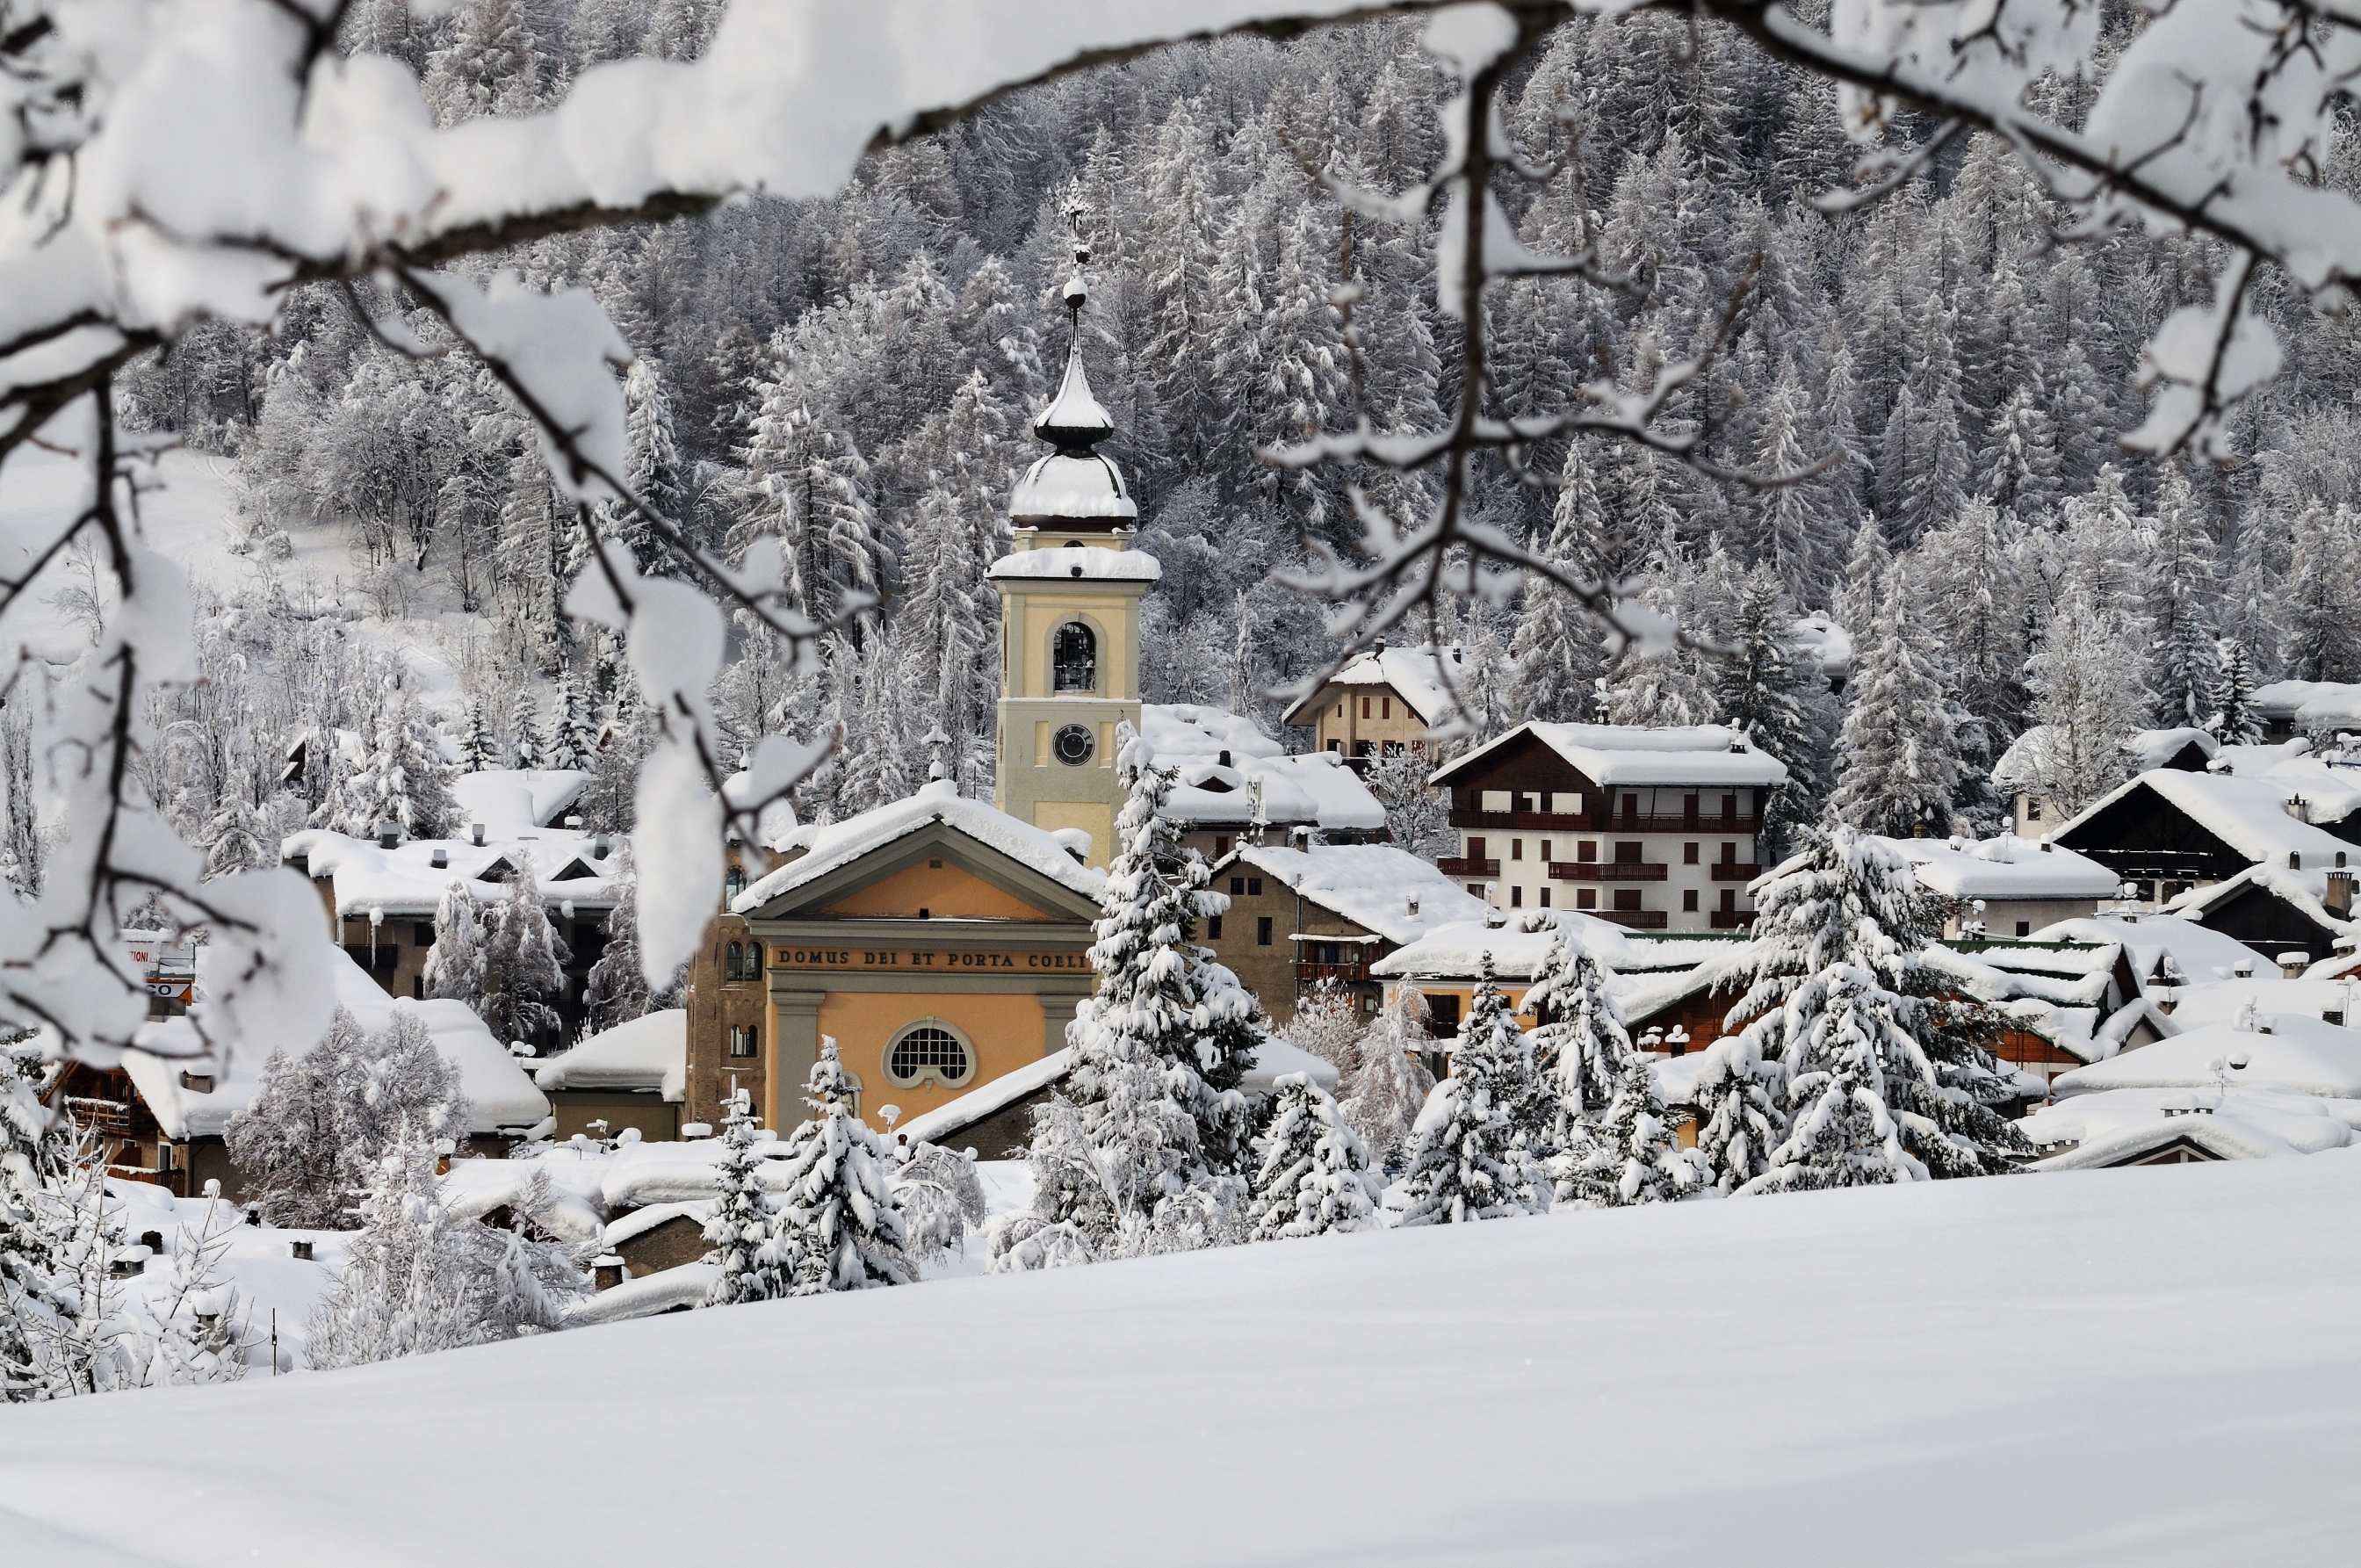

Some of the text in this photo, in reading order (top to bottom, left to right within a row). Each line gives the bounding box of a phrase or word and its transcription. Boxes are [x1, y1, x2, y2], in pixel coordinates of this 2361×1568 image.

[778, 950, 1086, 968] DOMUS DEI ET PORTA COELI
